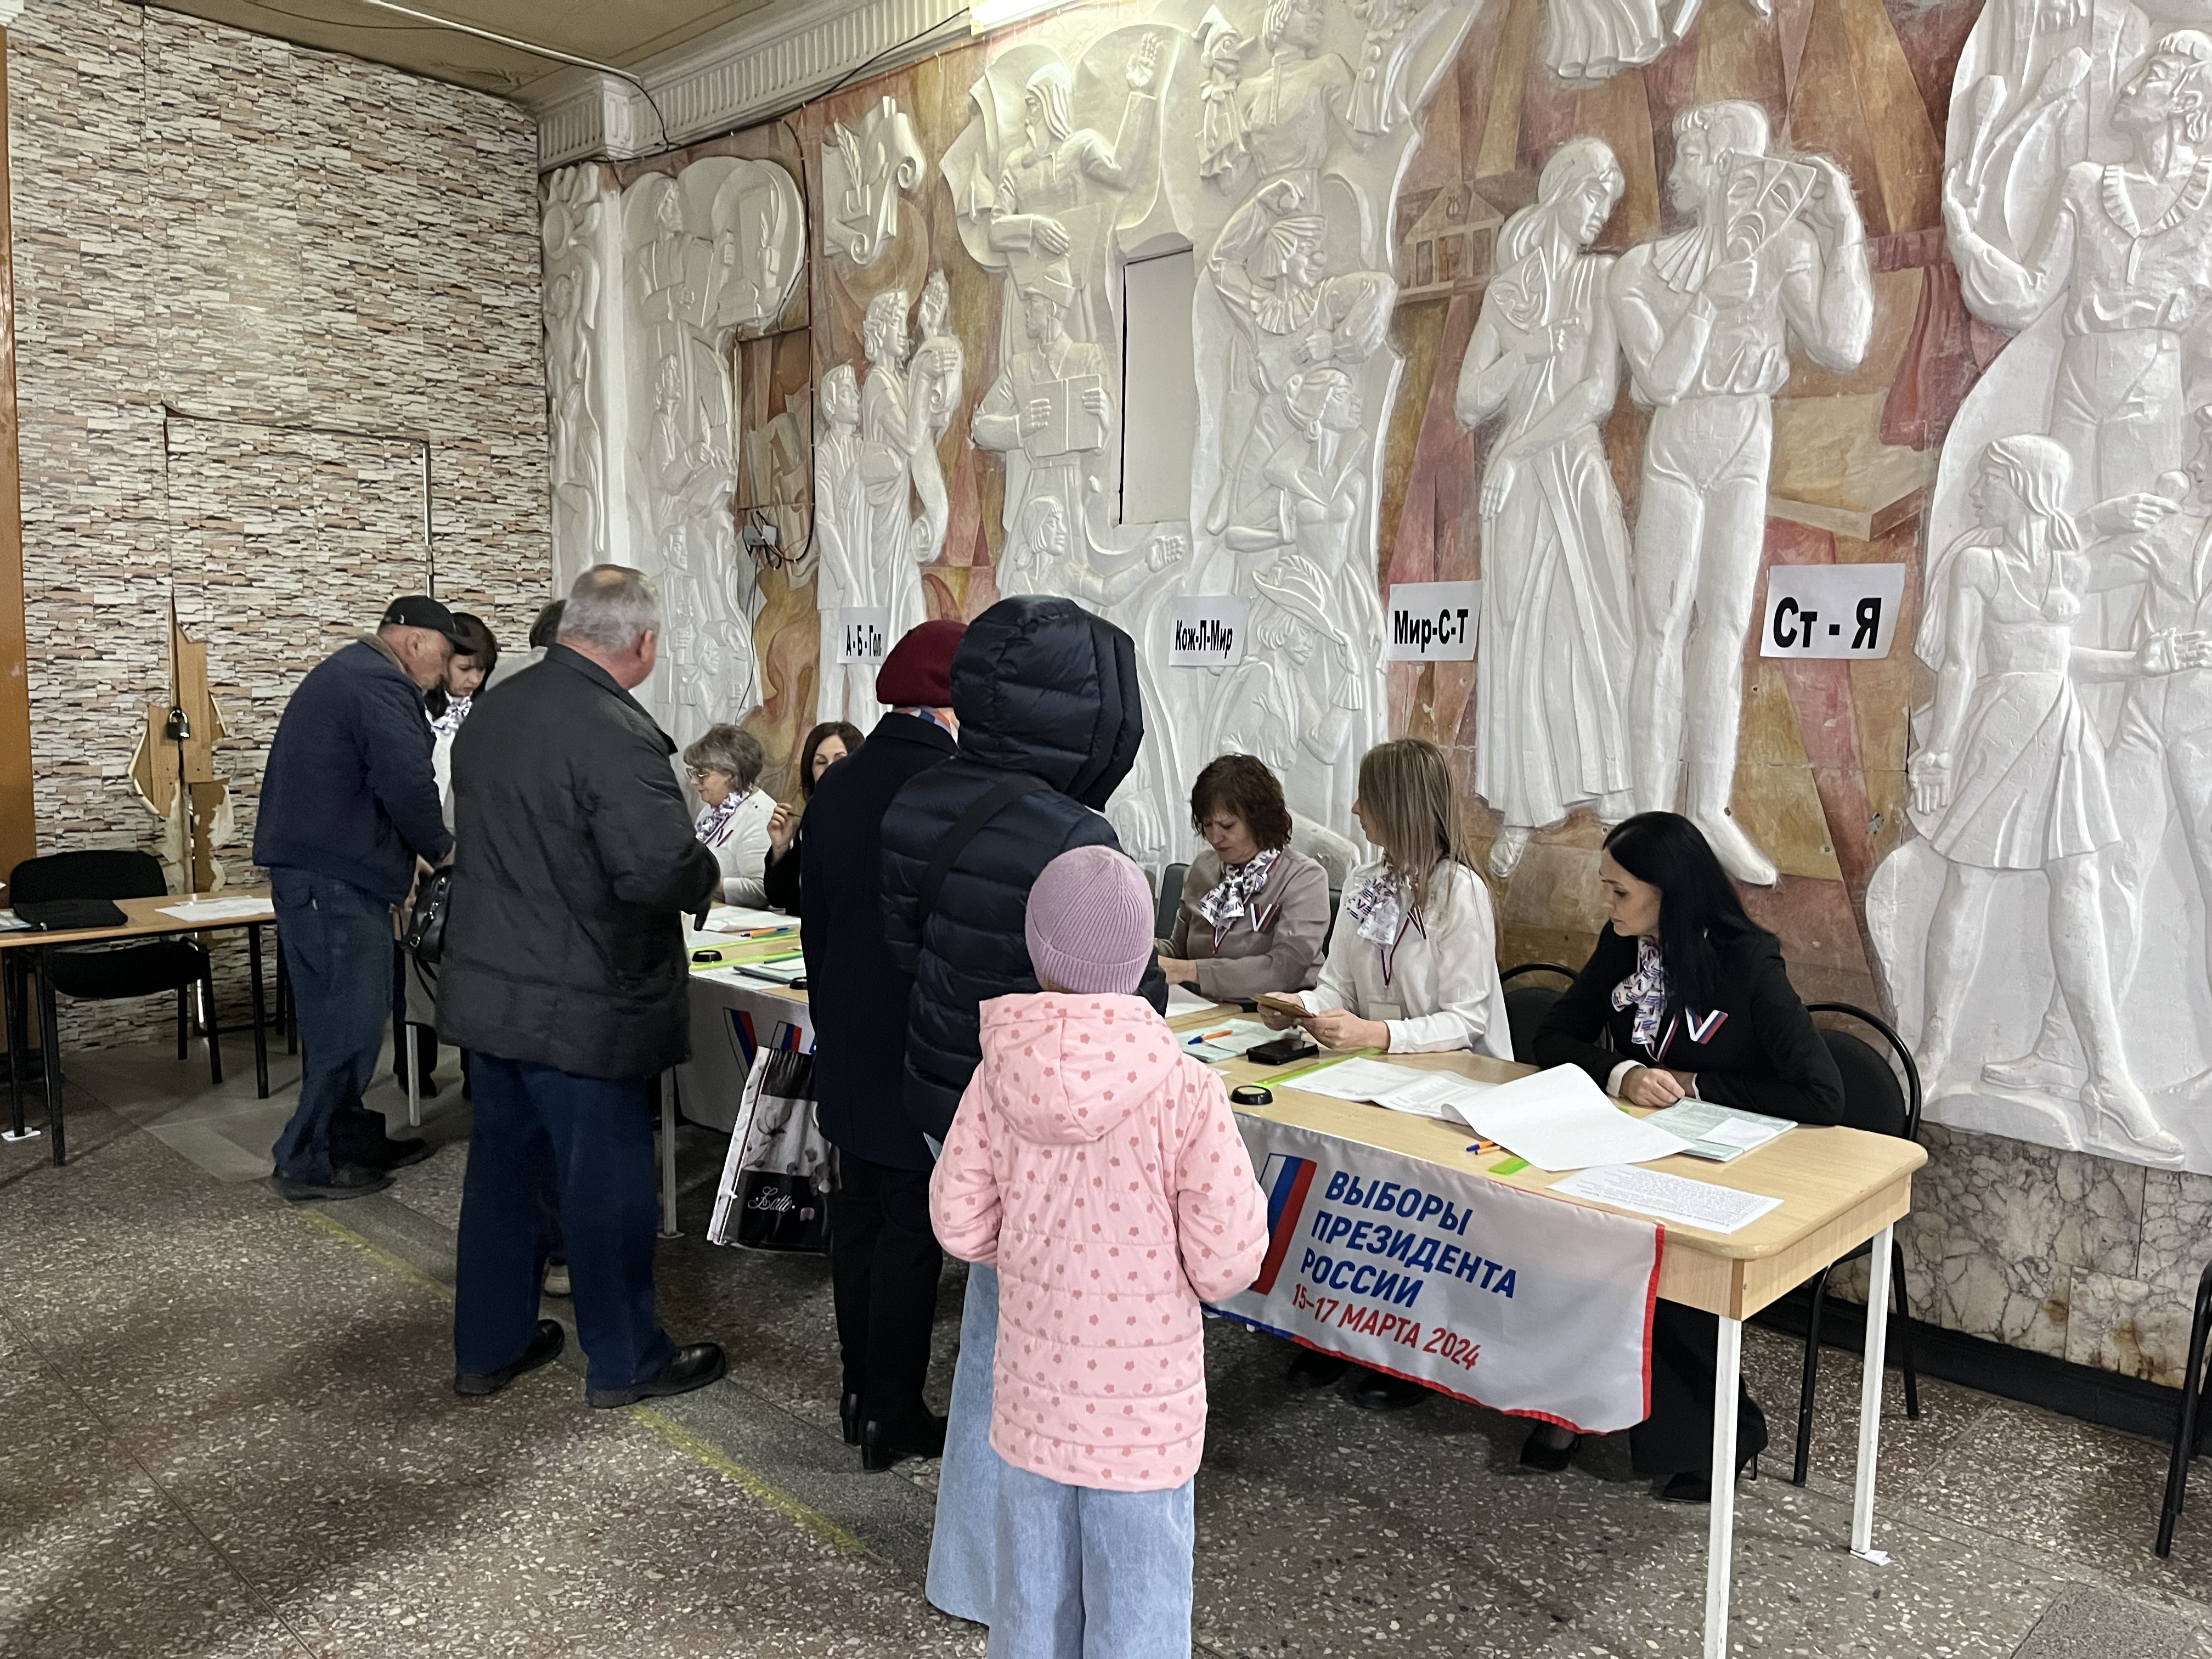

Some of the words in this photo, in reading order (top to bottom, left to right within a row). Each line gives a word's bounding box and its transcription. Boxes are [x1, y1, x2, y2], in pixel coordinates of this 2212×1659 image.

[1175, 620, 1233, 659] Кож-Л-Мир
[1394, 609, 1469, 653] Мир-С-Т
[1773, 596, 1818, 648] Ст
[1851, 597, 1882, 649] Я
[1324, 1171, 1473, 1235] ВЫБОРЫ
[1300, 1247, 1424, 1307] РОССИИ
[1311, 1210, 1516, 1299] ПРЕЗИДЕНТА
[1337, 1304, 1421, 1348] МАРТА
[1423, 1328, 1481, 1370] 2024
